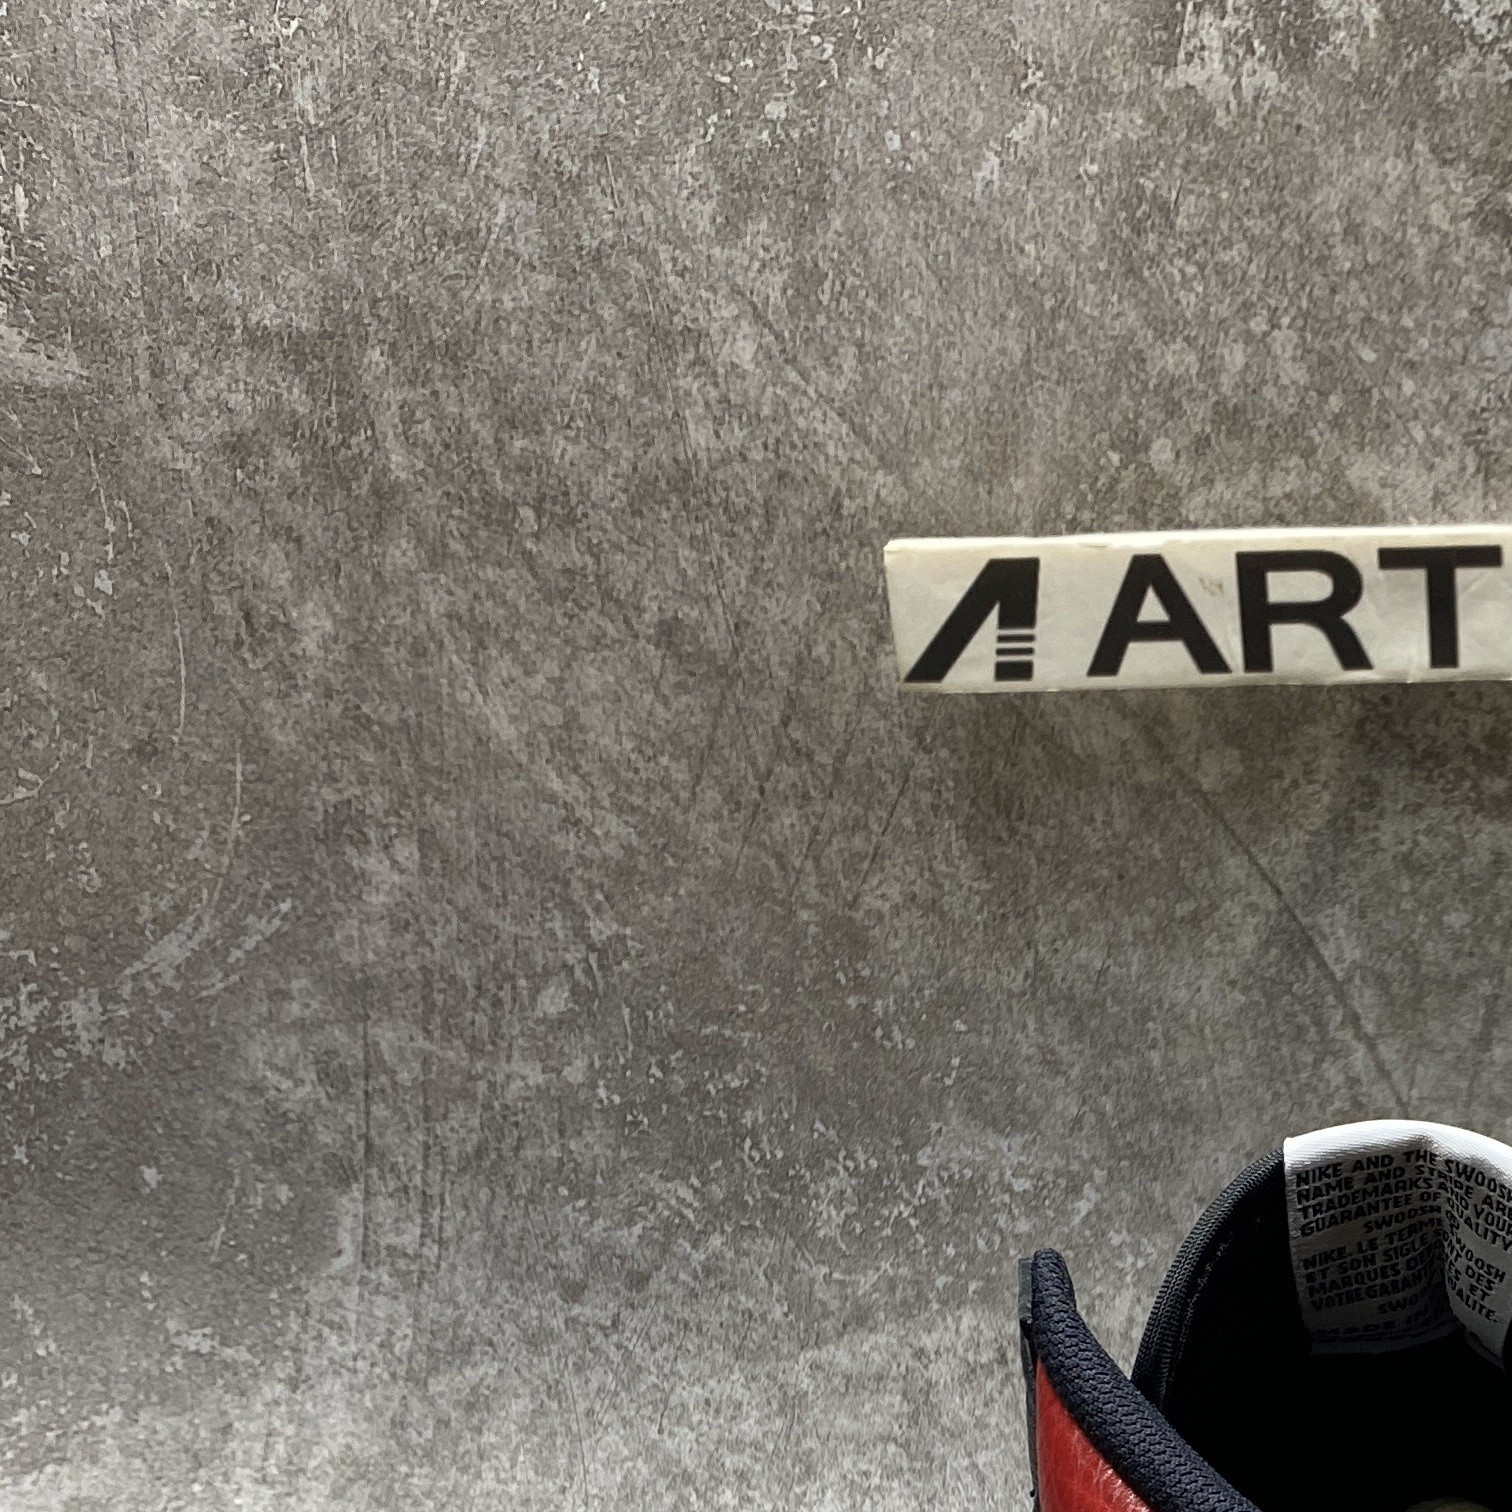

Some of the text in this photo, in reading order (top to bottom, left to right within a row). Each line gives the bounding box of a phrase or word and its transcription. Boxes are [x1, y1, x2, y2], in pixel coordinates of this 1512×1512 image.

[1296, 1162, 1342, 1188] NIKE
[1352, 1154, 1394, 1173] AND
[1403, 1149, 1438, 1165] THE
[1296, 1177, 1353, 1205] NAME
[1364, 1166, 1405, 1185] AND
[1298, 1176, 1434, 1220] TRADEMARKS
[1437, 1181, 1470, 1213] AND
[1300, 1193, 1413, 1237] GUARANTEE
[1420, 1190, 1442, 1203] OF
[1357, 1237, 1379, 1254] LE
[1385, 1217, 1443, 1246] TERME
[1305, 1267, 1330, 1284] ET
[1337, 1253, 1376, 1274] SON
[1383, 1233, 1428, 1263] SIGLE
[1465, 1264, 1497, 1293] DES
[1308, 1262, 1401, 1298] MARQUES
[1469, 1283, 1491, 1302] ET
